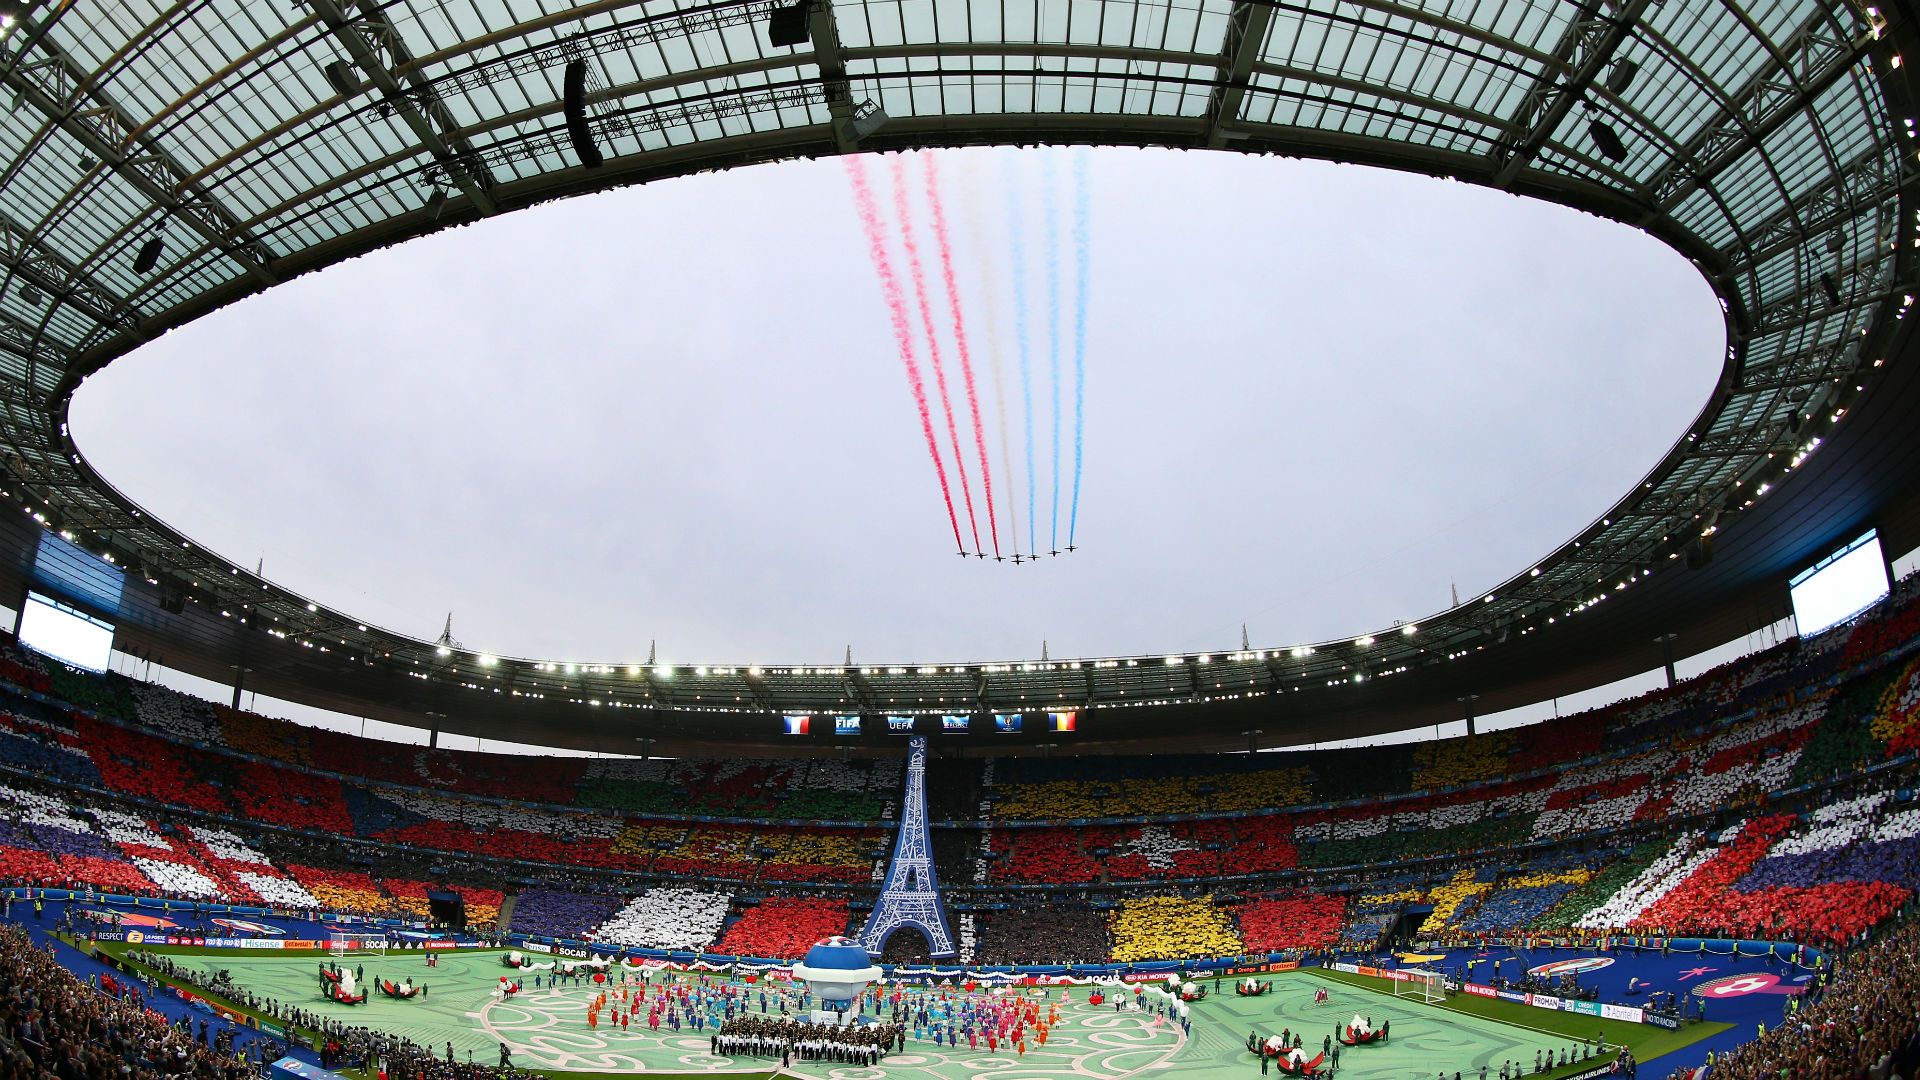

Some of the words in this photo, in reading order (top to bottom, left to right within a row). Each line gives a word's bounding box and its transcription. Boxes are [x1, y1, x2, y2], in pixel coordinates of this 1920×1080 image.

[837, 720, 860, 729] FIFA
[889, 722, 913, 730] UEFA
[98, 932, 124, 941] RESPECT
[245, 939, 280, 948] Hisense
[365, 940, 389, 949] SOCAR
[559, 947, 587, 958] SOCAR
[1186, 970, 1214, 978] Probably
[1535, 996, 1558, 1007] PROMAN
[1612, 1007, 1640, 1020] Abritel.fr
[1660, 1018, 1677, 1028] RACISM
[262, 1023, 284, 1037] Hisense
[1583, 1065, 1611, 1080] AIRLINES
